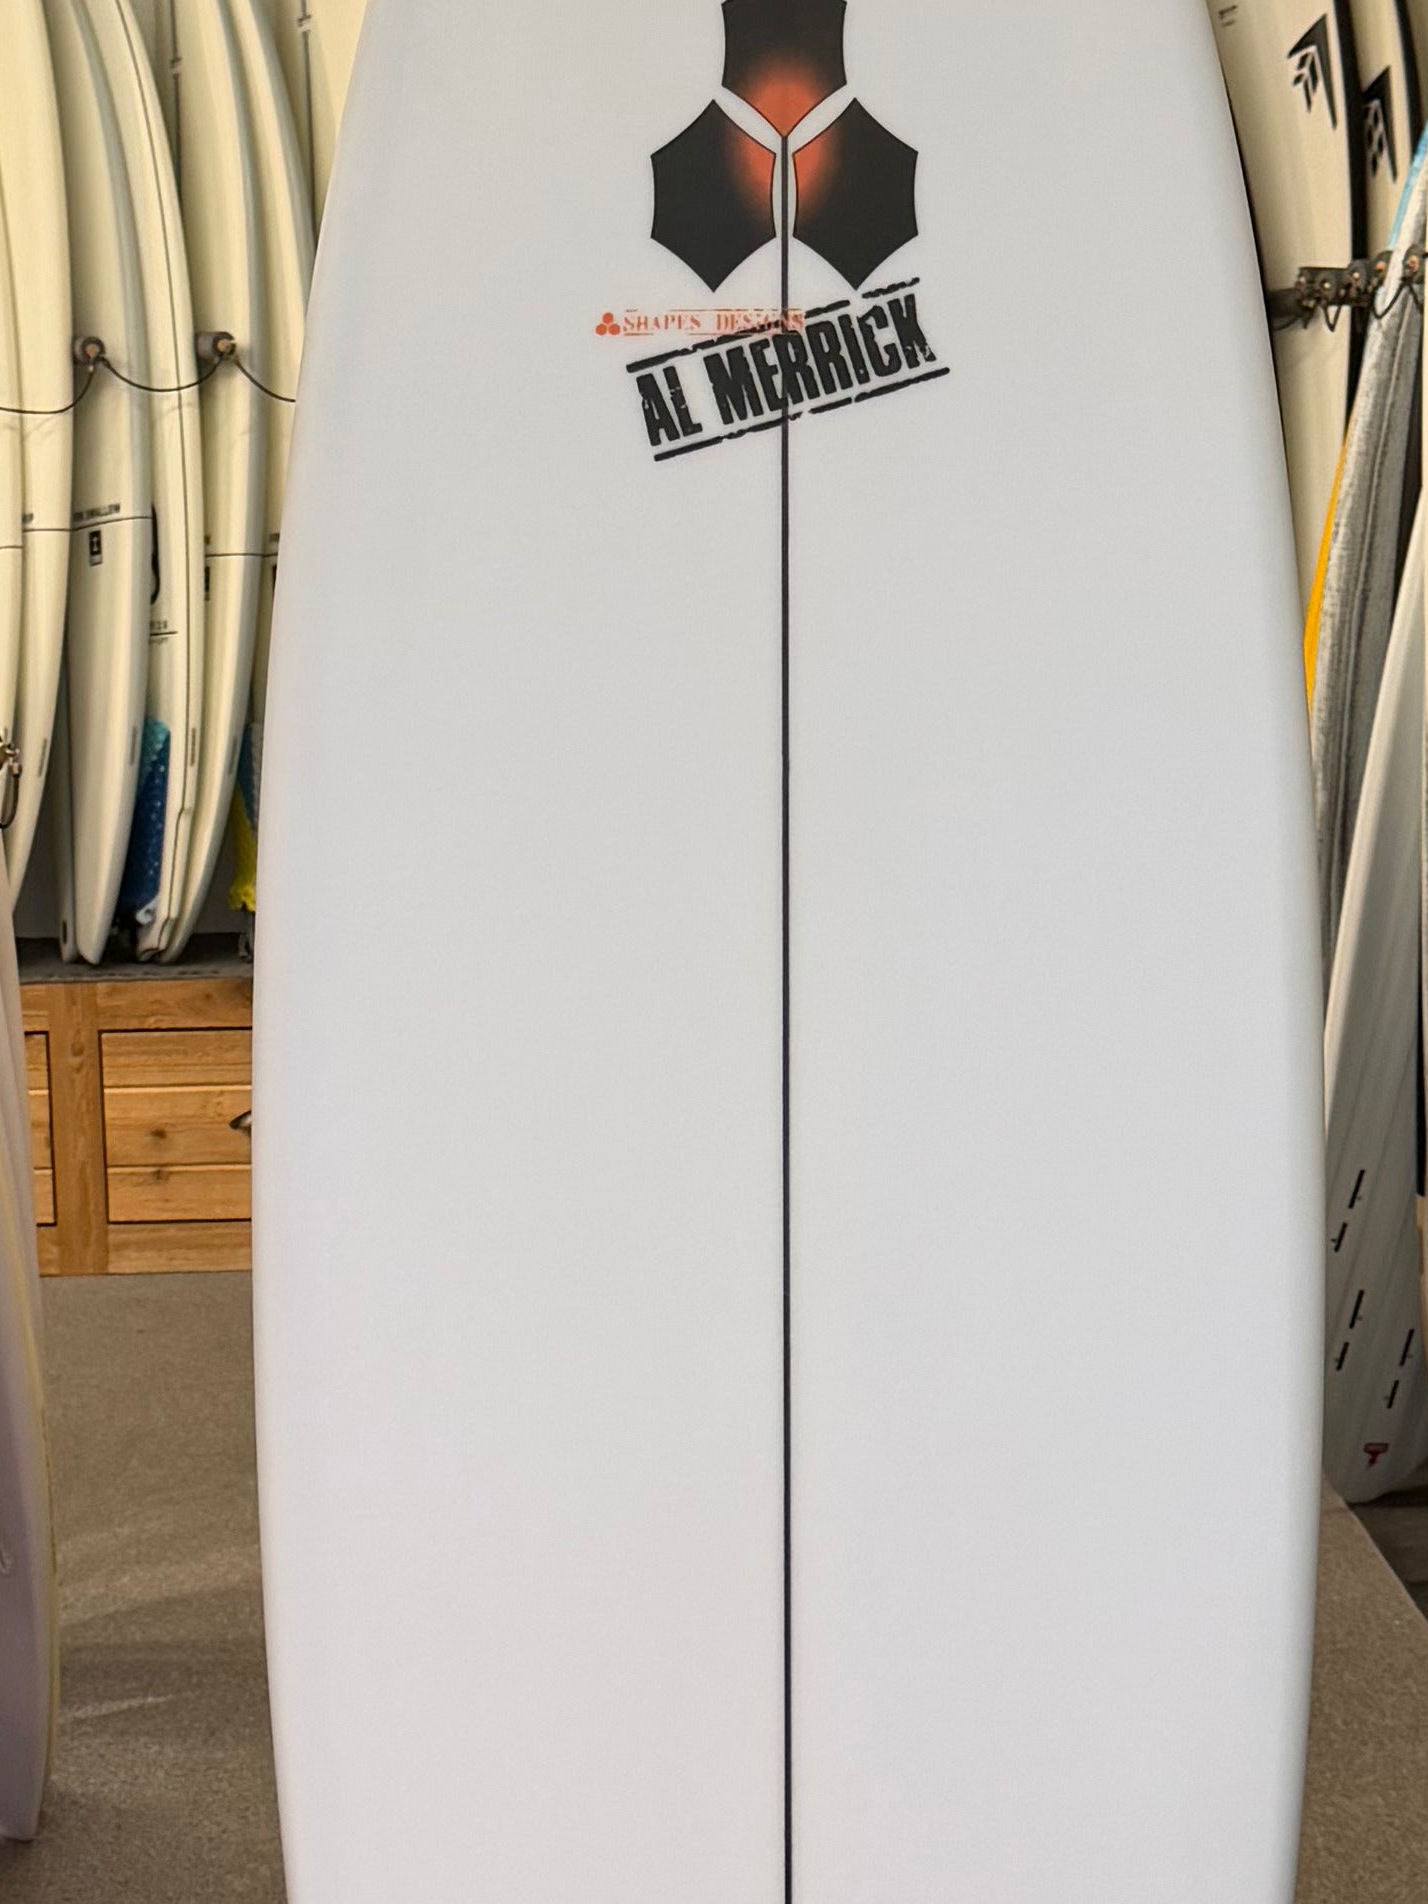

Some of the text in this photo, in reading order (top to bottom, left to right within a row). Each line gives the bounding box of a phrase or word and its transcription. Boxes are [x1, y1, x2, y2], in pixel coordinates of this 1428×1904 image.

[623, 311, 805, 333] SHAPES DESIGNS
[636, 293, 938, 447] AL MERRICK
